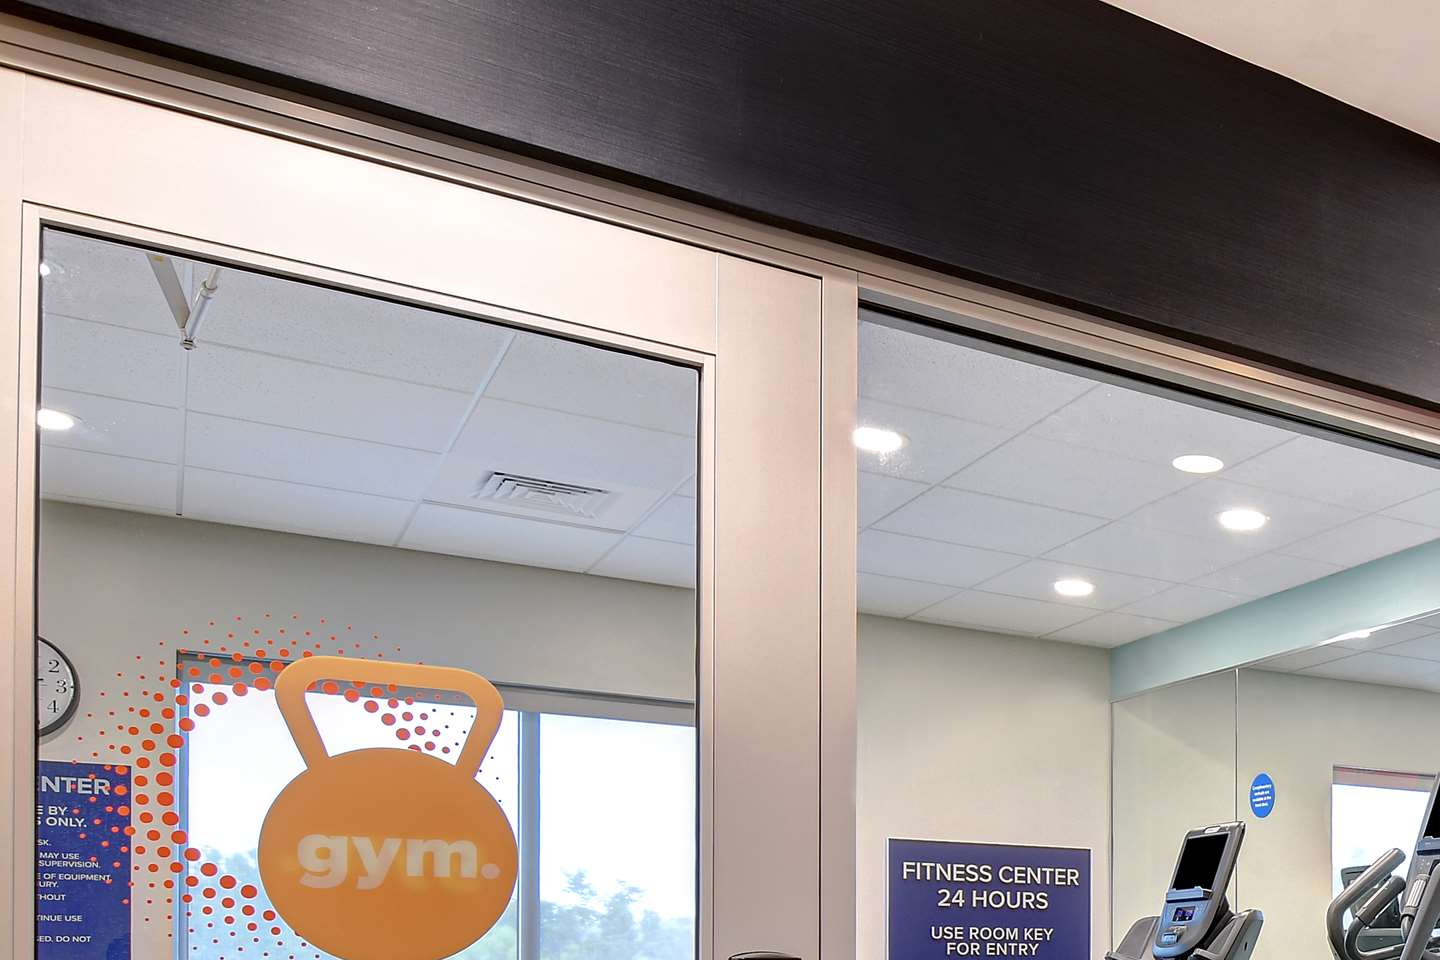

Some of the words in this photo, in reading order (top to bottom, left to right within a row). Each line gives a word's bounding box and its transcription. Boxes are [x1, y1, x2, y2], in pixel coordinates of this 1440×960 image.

[48, 659, 60, 673] 2
[55, 679, 67, 694] 3
[47, 700, 60, 713] 4
[40, 775, 110, 795] NTER
[48, 805, 68, 815] BY
[46, 816, 87, 828] ONLY.
[39, 852, 59, 860] MAY
[297, 834, 501, 891] gym.
[38, 860, 101, 868] SUPERVISION.
[902, 861, 992, 882] FITNESS
[998, 866, 1080, 886] CENTER
[937, 889, 965, 907] 24
[972, 890, 1049, 910] HOURS
[56, 935, 71, 943] DO
[72, 935, 91, 943] NOT
[931, 926, 964, 940] USE
[969, 927, 1019, 940] ROOM
[1024, 928, 1054, 941] KEY
[946, 942, 980, 956] FOR
[986, 943, 1040, 956] ENTRY
